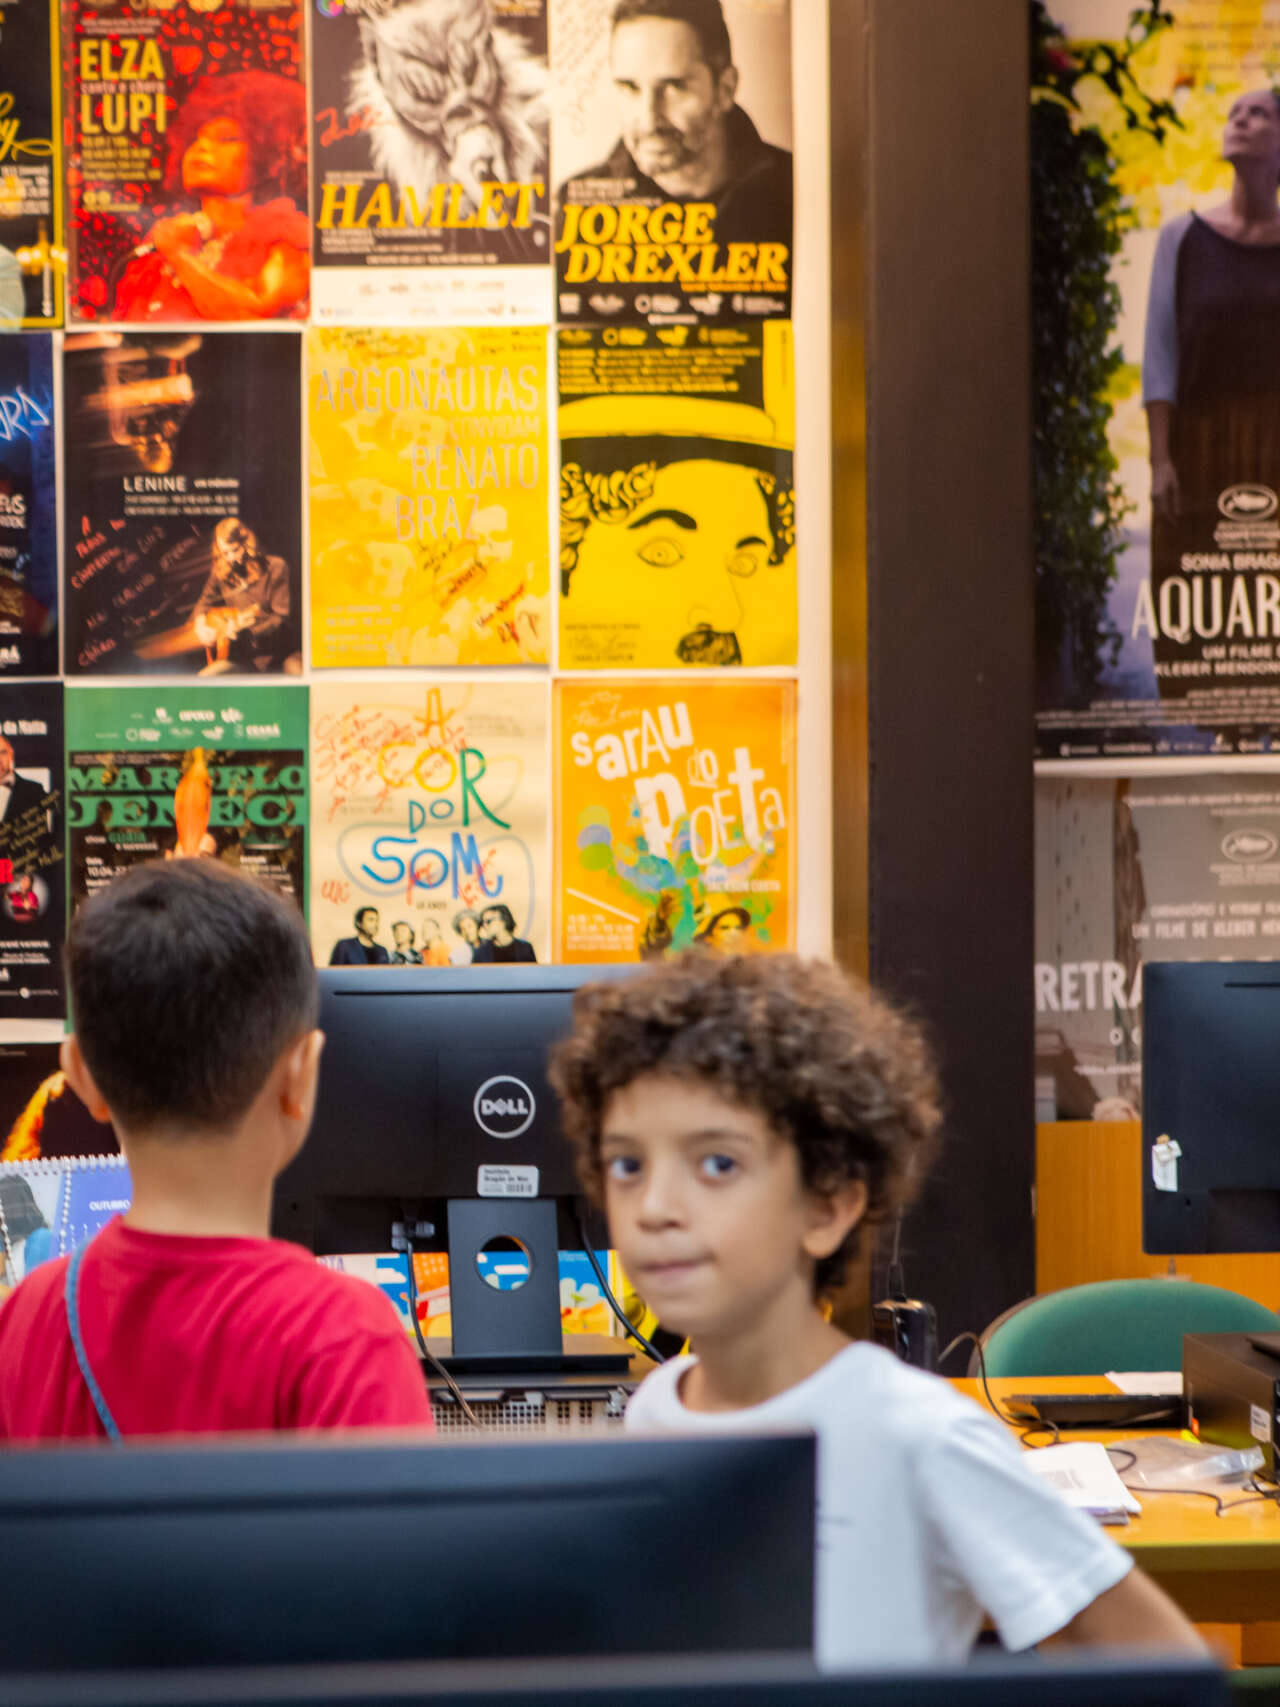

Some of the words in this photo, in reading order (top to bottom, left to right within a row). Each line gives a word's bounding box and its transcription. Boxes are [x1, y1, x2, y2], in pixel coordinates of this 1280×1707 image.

[80, 39, 166, 80] ELZA
[80, 93, 167, 134] LUPI
[316, 181, 546, 229] HAMLET
[554, 202, 717, 253] JORGE
[564, 242, 789, 283] DREXLER
[315, 364, 540, 413] ARGONAUTAS
[123, 475, 187, 492] LENINE
[411, 443, 540, 490] RENATO
[395, 494, 482, 541] BRAZ
[414, 686, 457, 744] A
[377, 744, 512, 831] COR
[408, 799, 455, 834] DO
[361, 831, 504, 900] SOM
[1191, 921, 1208, 939] DE
[481, 1097, 529, 1117] DELL
